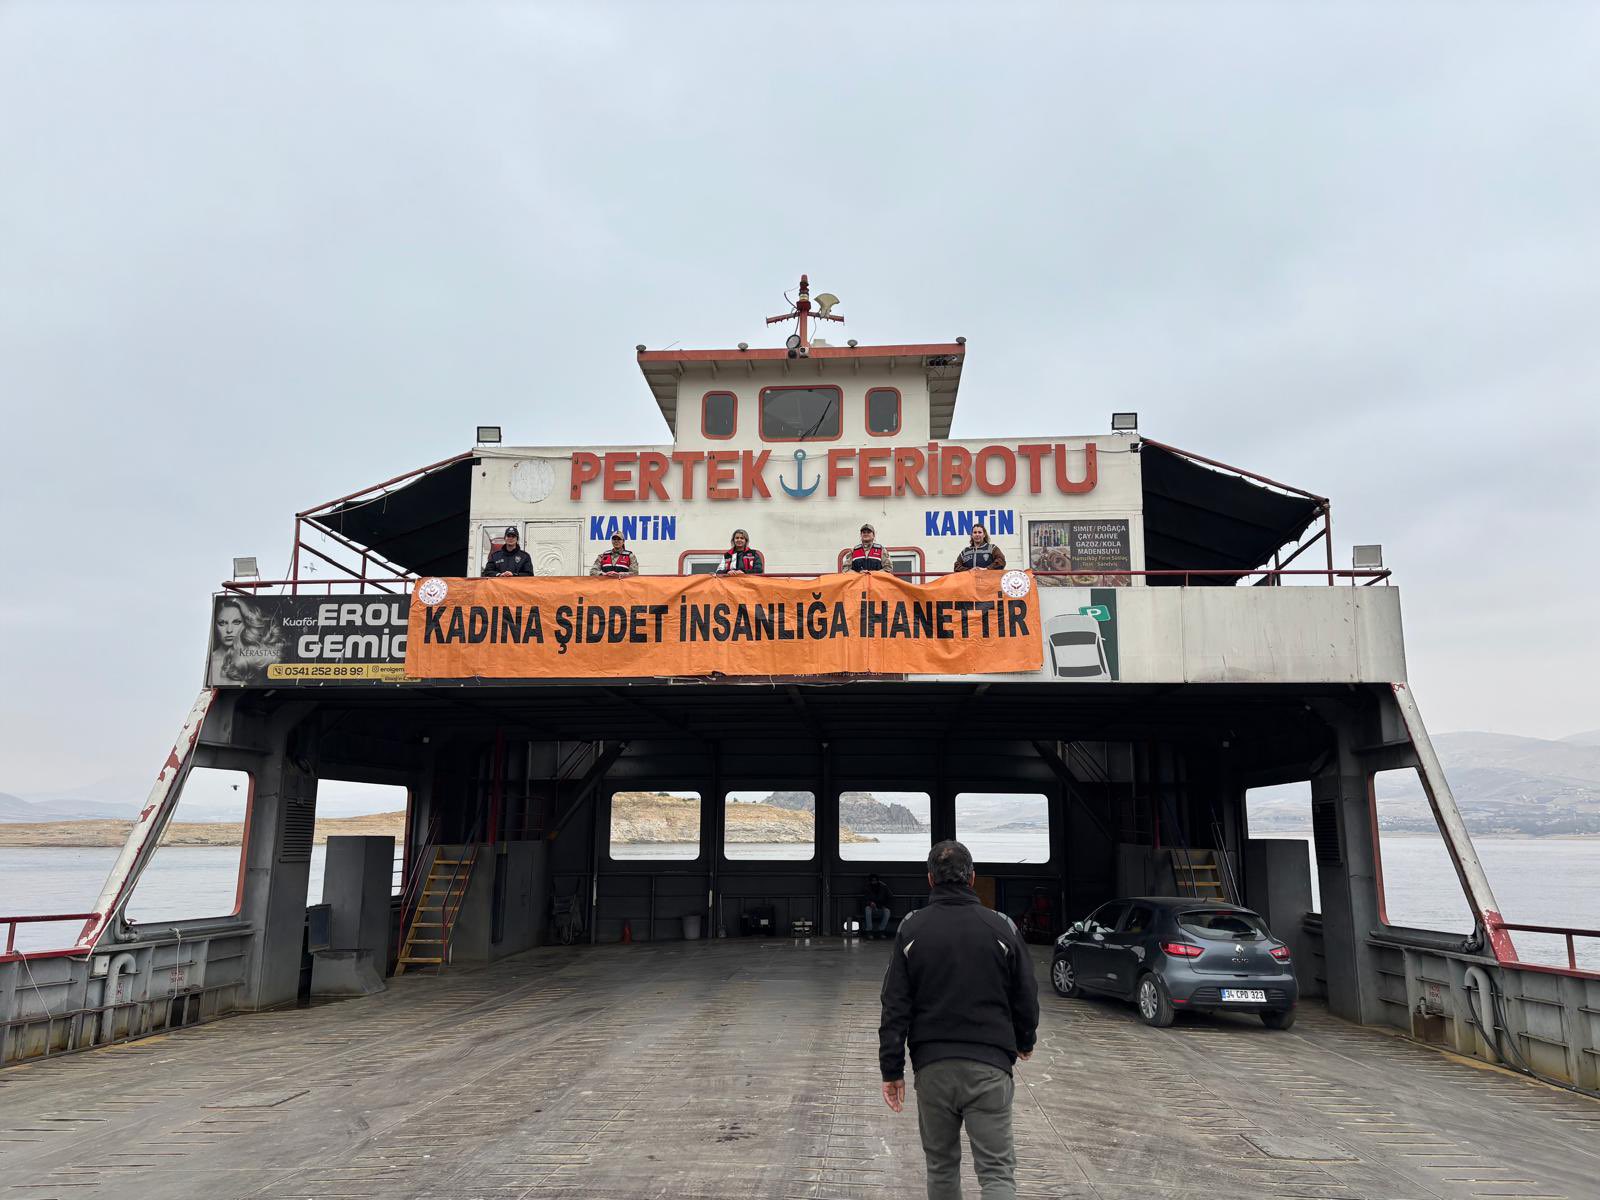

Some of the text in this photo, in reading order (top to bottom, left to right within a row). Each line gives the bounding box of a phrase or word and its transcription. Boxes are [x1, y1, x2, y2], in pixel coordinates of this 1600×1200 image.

[570, 449, 772, 501] PERTEK
[282, 603, 409, 627] Kuaför EROL
[423, 591, 1030, 654] KADINA ŞİDDET İNSANLIĞA İHANETTİR
[284, 666, 310, 676] 0541
[311, 666, 332, 676] 252
[333, 666, 348, 676] 88
[349, 666, 364, 676] 99
[1225, 990, 1235, 999] 34
[1250, 990, 1264, 1000] 323
